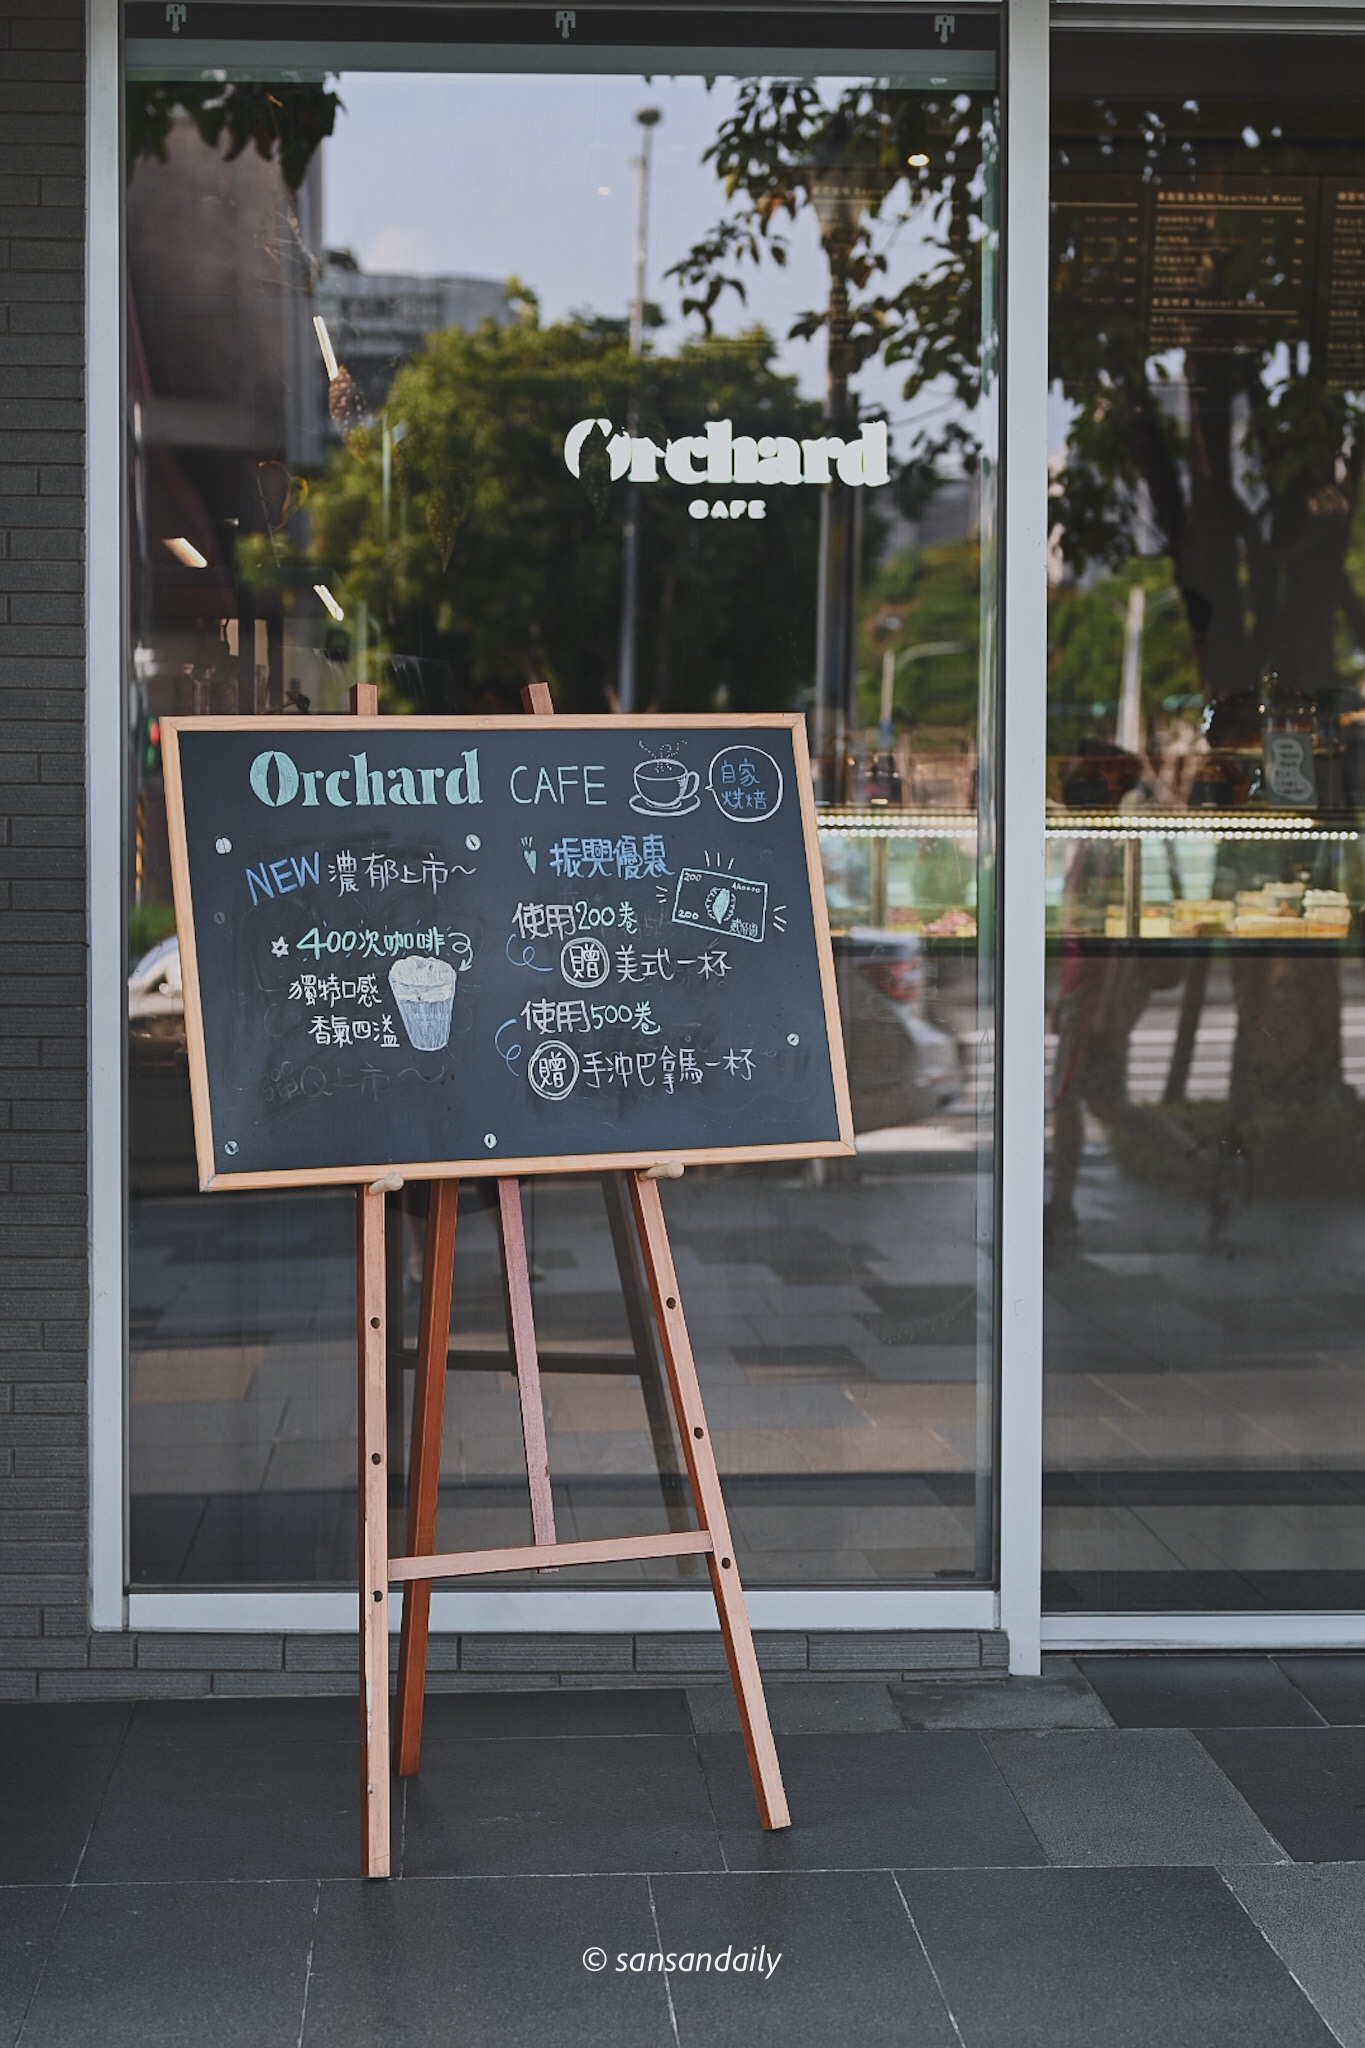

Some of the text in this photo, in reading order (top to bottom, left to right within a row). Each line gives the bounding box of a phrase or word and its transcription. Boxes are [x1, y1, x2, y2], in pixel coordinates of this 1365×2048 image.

[564, 418, 891, 487] Orchard
[688, 499, 766, 519] CAFE
[250, 748, 608, 807] Orchard CAFE
[721, 757, 760, 786] 自家
[721, 787, 767, 810] 烘焙
[549, 834, 675, 880] 振興優惠
[245, 852, 319, 905] NEW
[683, 872, 702, 882] 200
[678, 909, 699, 920] 200
[296, 926, 446, 960] 400次咖啡
[615, 945, 732, 984] 美式一杯
[288, 973, 383, 1009] 獨特口感
[307, 1014, 401, 1048] 香氣四溢
